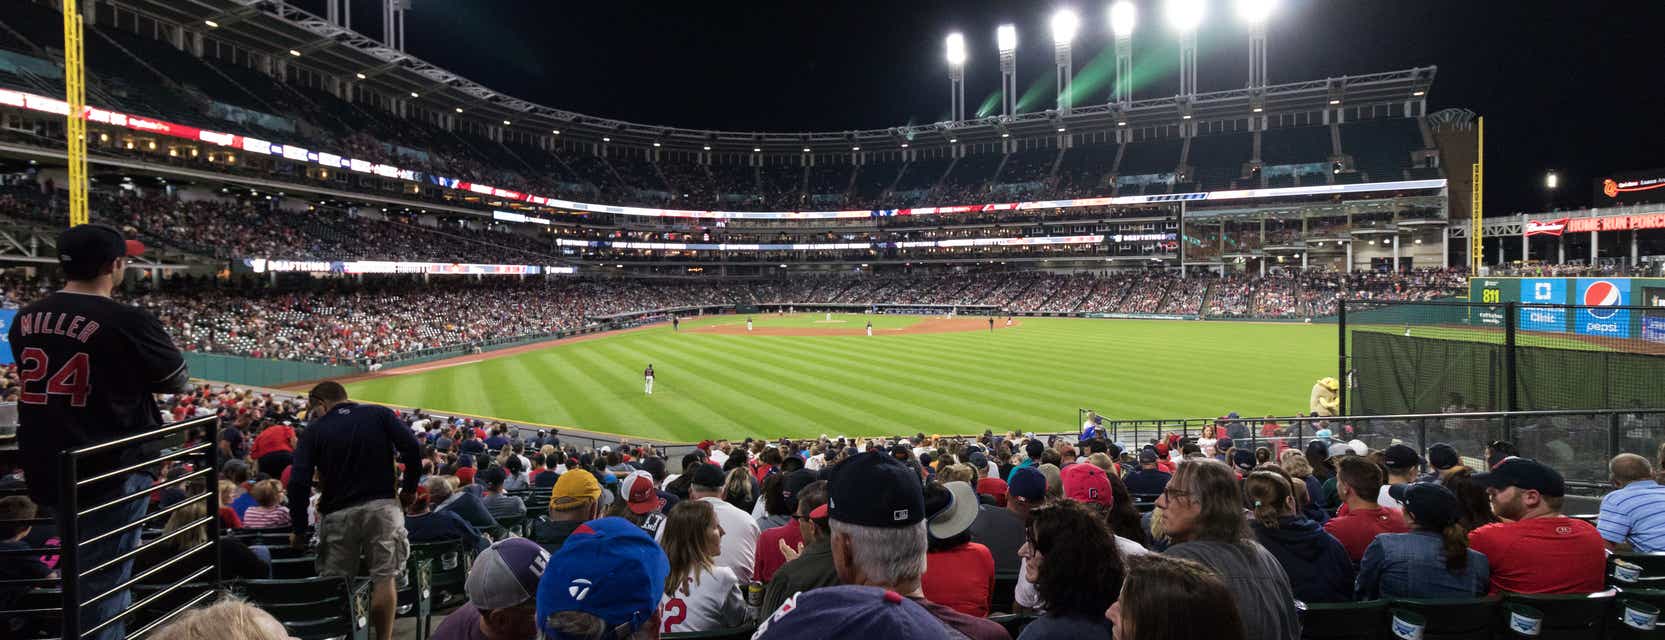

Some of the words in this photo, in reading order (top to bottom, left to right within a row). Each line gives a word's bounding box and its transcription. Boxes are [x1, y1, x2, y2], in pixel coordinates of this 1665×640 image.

[1568, 219, 1601, 232] HOME
[1603, 217, 1627, 230] RUN
[1631, 213, 1665, 229] PORC
[1483, 289, 1500, 303] 811
[21, 312, 100, 343] MILLER
[1587, 322, 1617, 332] pepsi
[20, 347, 91, 407] 24
